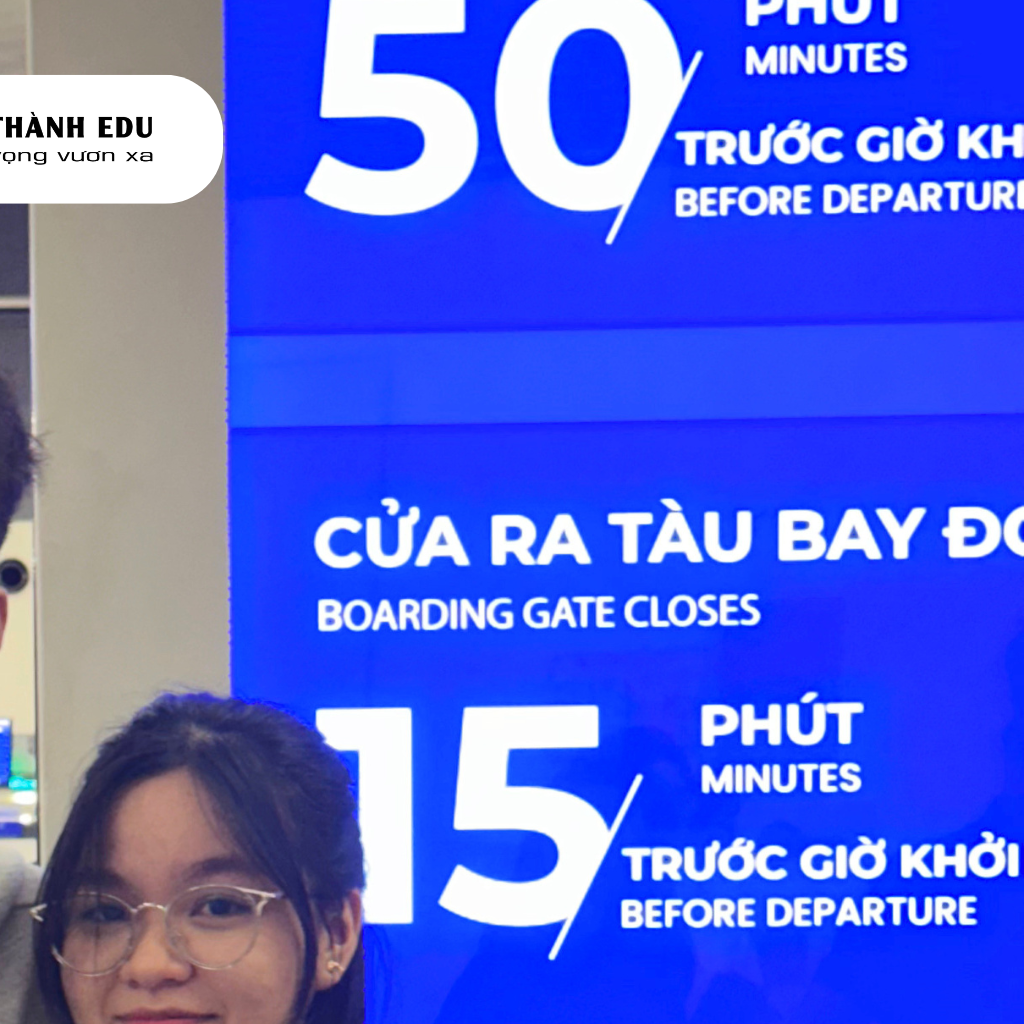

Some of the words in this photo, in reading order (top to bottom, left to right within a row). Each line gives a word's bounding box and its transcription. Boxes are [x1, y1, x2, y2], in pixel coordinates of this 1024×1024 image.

[745, 42, 908, 75] MINUTES
[675, 119, 843, 166] TRƯỚC
[857, 116, 944, 163] GIỜ
[675, 184, 812, 217] BEFORE
[314, 497, 470, 569] CỬA
[491, 513, 592, 566] RA
[607, 498, 752, 564] TÀU
[779, 508, 927, 561] BAY
[317, 597, 514, 632] BOARDING
[522, 595, 616, 629] GATE
[624, 593, 761, 628] CLOSES
[701, 692, 864, 747] PHÚT
[701, 762, 862, 794] MINUTES
[621, 837, 788, 882] TRƯỚC
[799, 836, 887, 880] GIỜ
[900, 832, 1019, 878] KHỞI
[621, 898, 756, 929] BEFORE
[766, 896, 977, 928] DEPARTURE
